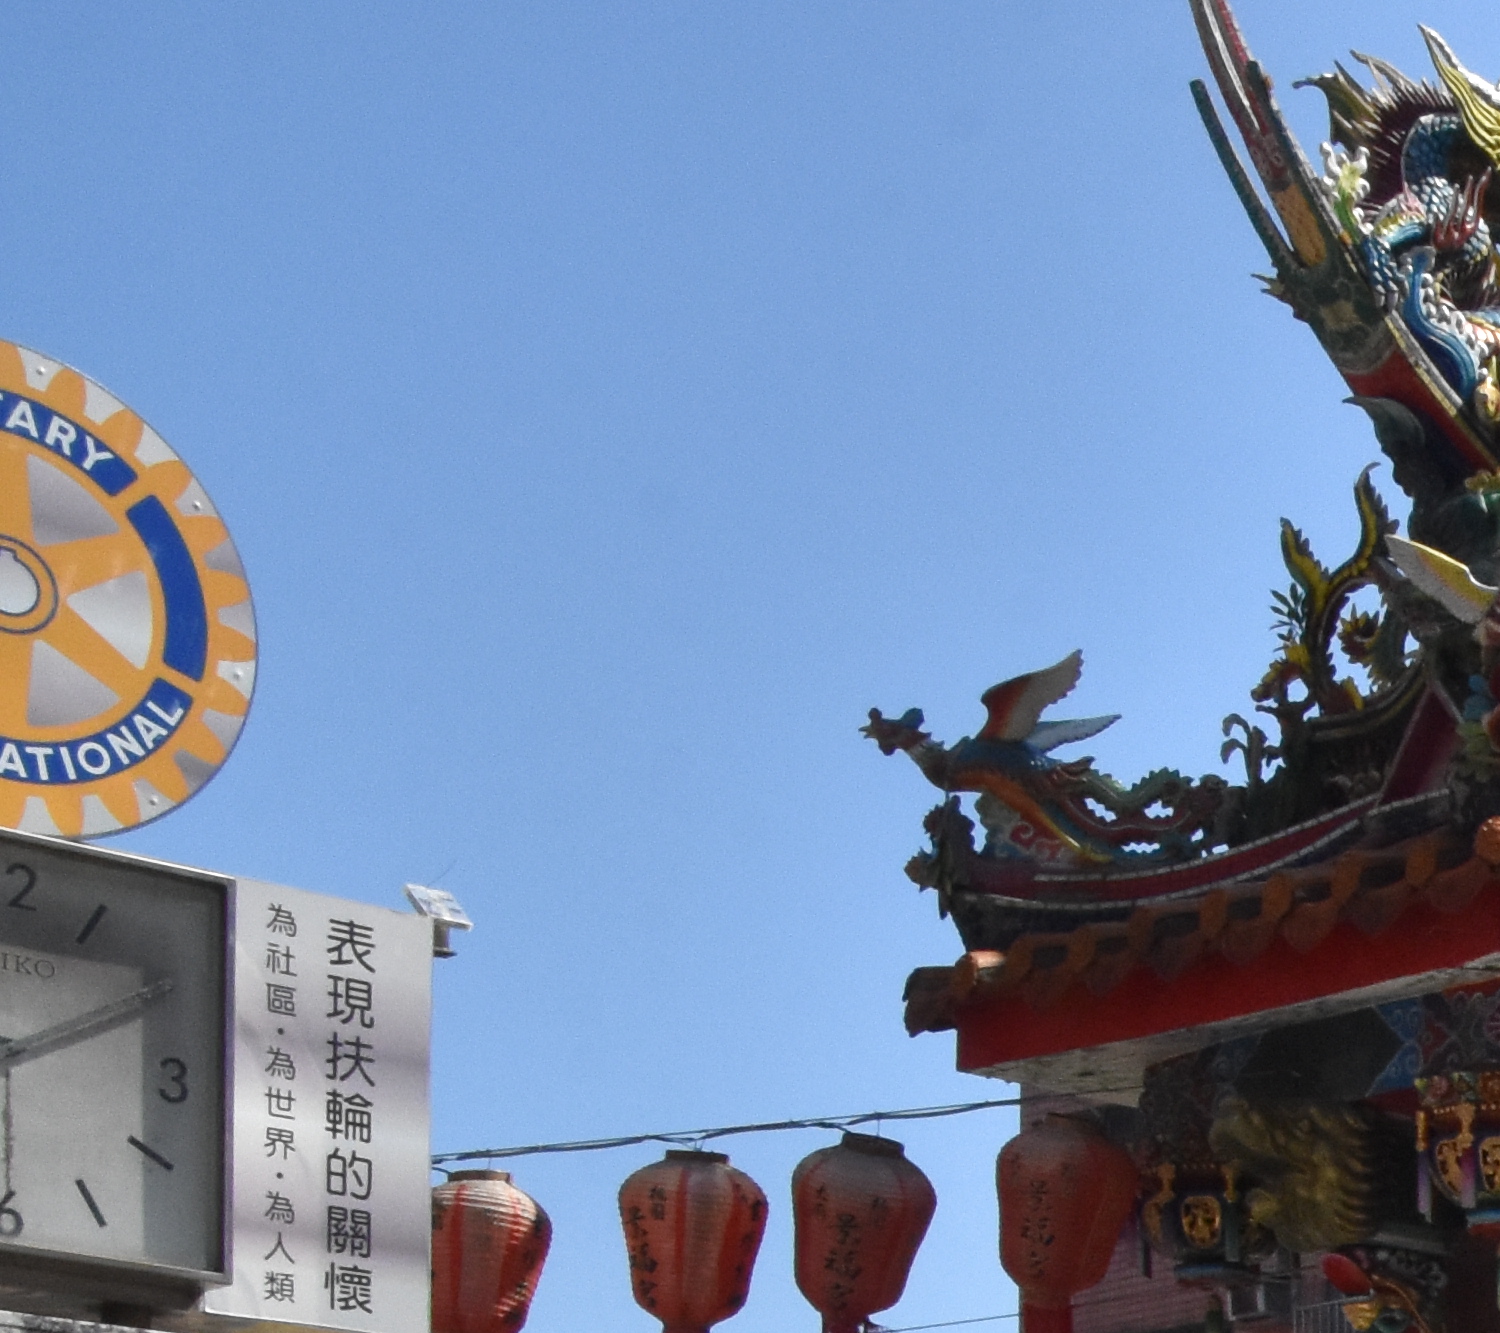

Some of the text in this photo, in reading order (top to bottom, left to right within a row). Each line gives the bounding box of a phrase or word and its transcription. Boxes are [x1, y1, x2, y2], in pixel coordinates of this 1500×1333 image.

[0, 392, 114, 470] ARY
[159, 1057, 189, 1104] 3
[324, 917, 377, 1315] 表現扶輪的關懷
